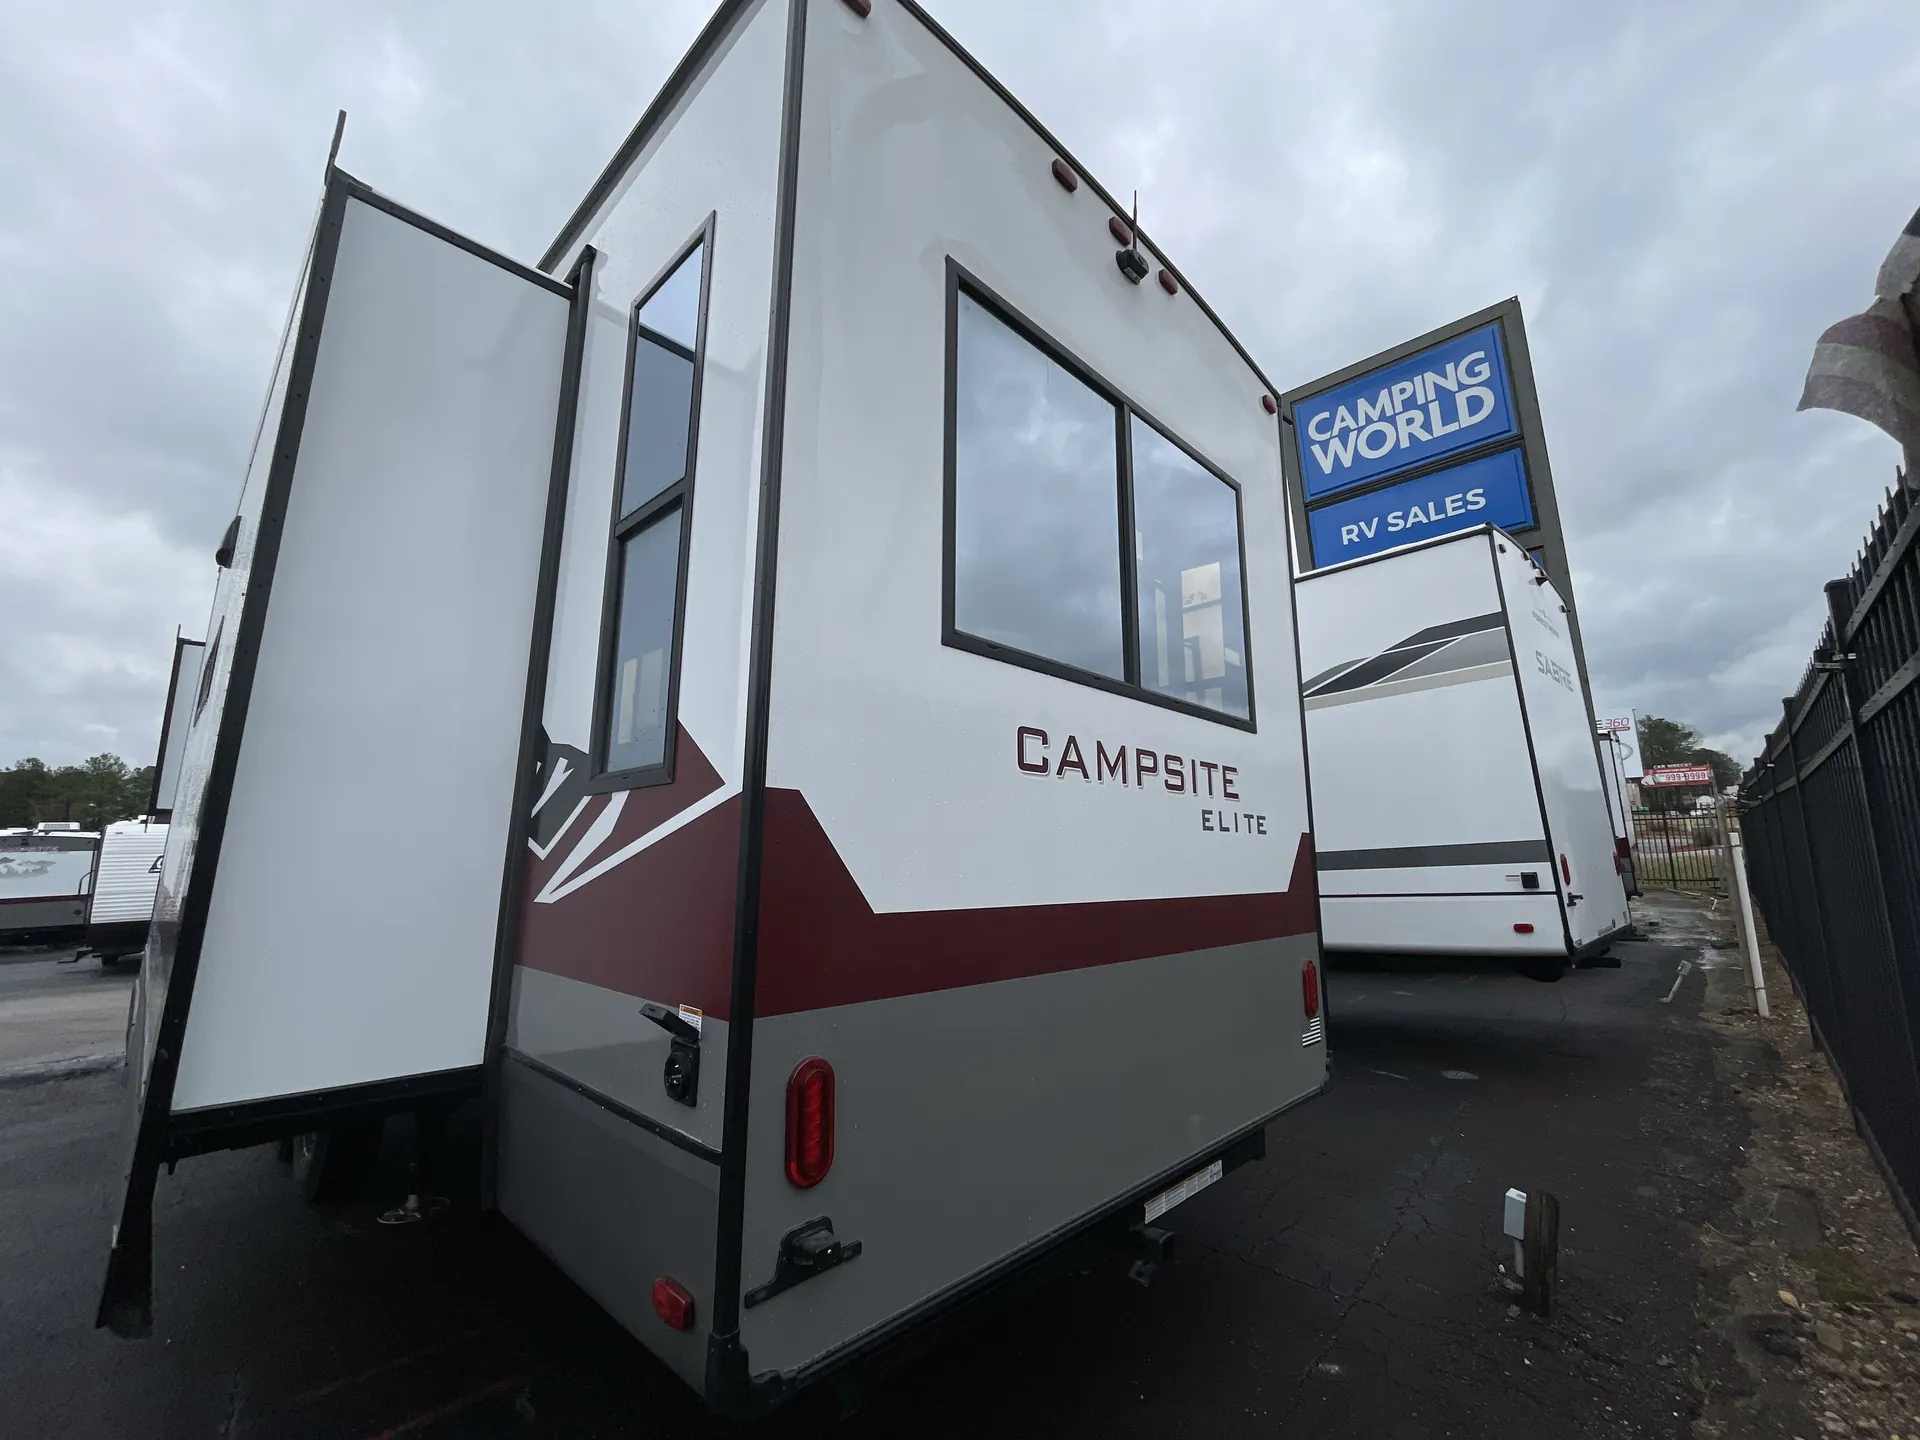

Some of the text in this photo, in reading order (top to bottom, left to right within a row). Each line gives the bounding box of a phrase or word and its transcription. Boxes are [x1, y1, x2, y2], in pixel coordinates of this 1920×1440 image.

[1308, 351, 1491, 441] CAMPING
[1311, 386, 1495, 475] WORLD
[1341, 488, 1486, 545] RV SALES
[1535, 650, 1574, 692] SABRE
[1605, 717, 1630, 728] 360
[1017, 725, 1240, 802] CAMPSITE
[1201, 809, 1267, 835] ELITE
